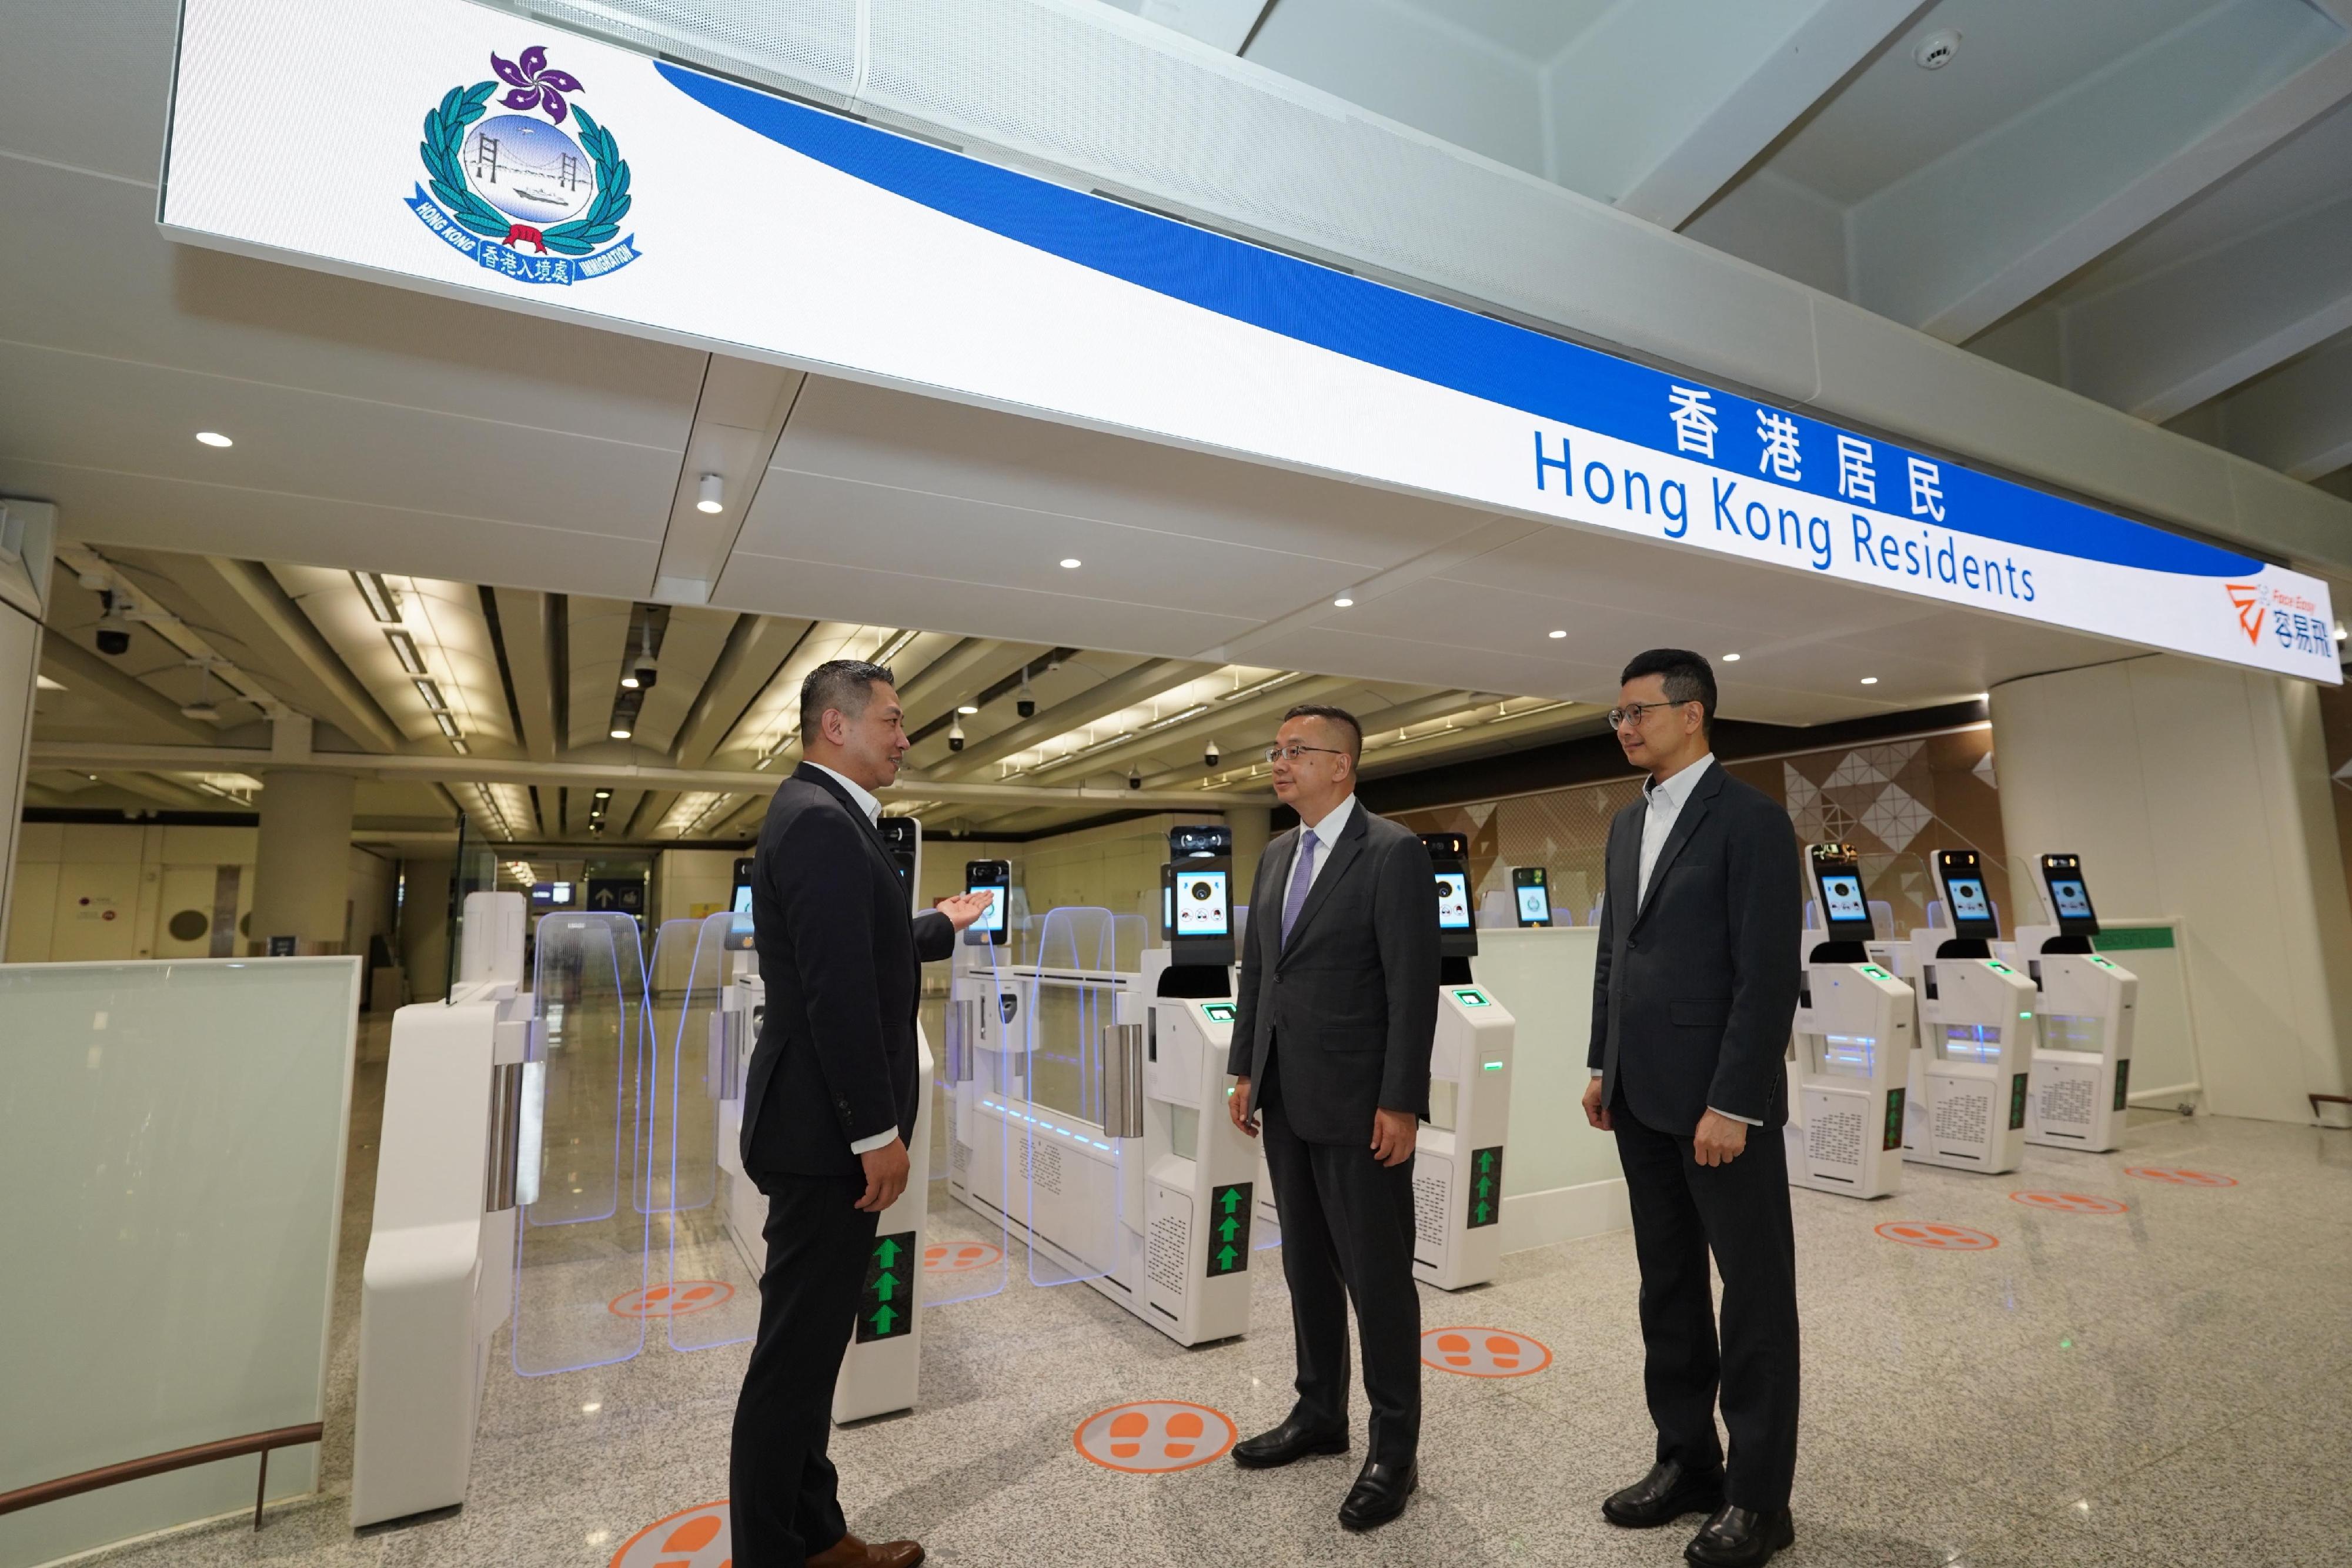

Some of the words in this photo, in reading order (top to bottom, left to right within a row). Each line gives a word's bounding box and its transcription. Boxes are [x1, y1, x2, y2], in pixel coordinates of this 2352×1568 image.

[416, 202, 448, 230] HONG
[441, 226, 476, 252] KONG
[482, 245, 569, 283] 香港入境處
[1669, 385, 1946, 522] 香港居民
[1534, 430, 1688, 539] Hong
[1712, 476, 1832, 571] Kong
[1851, 513, 2036, 602] Residents
